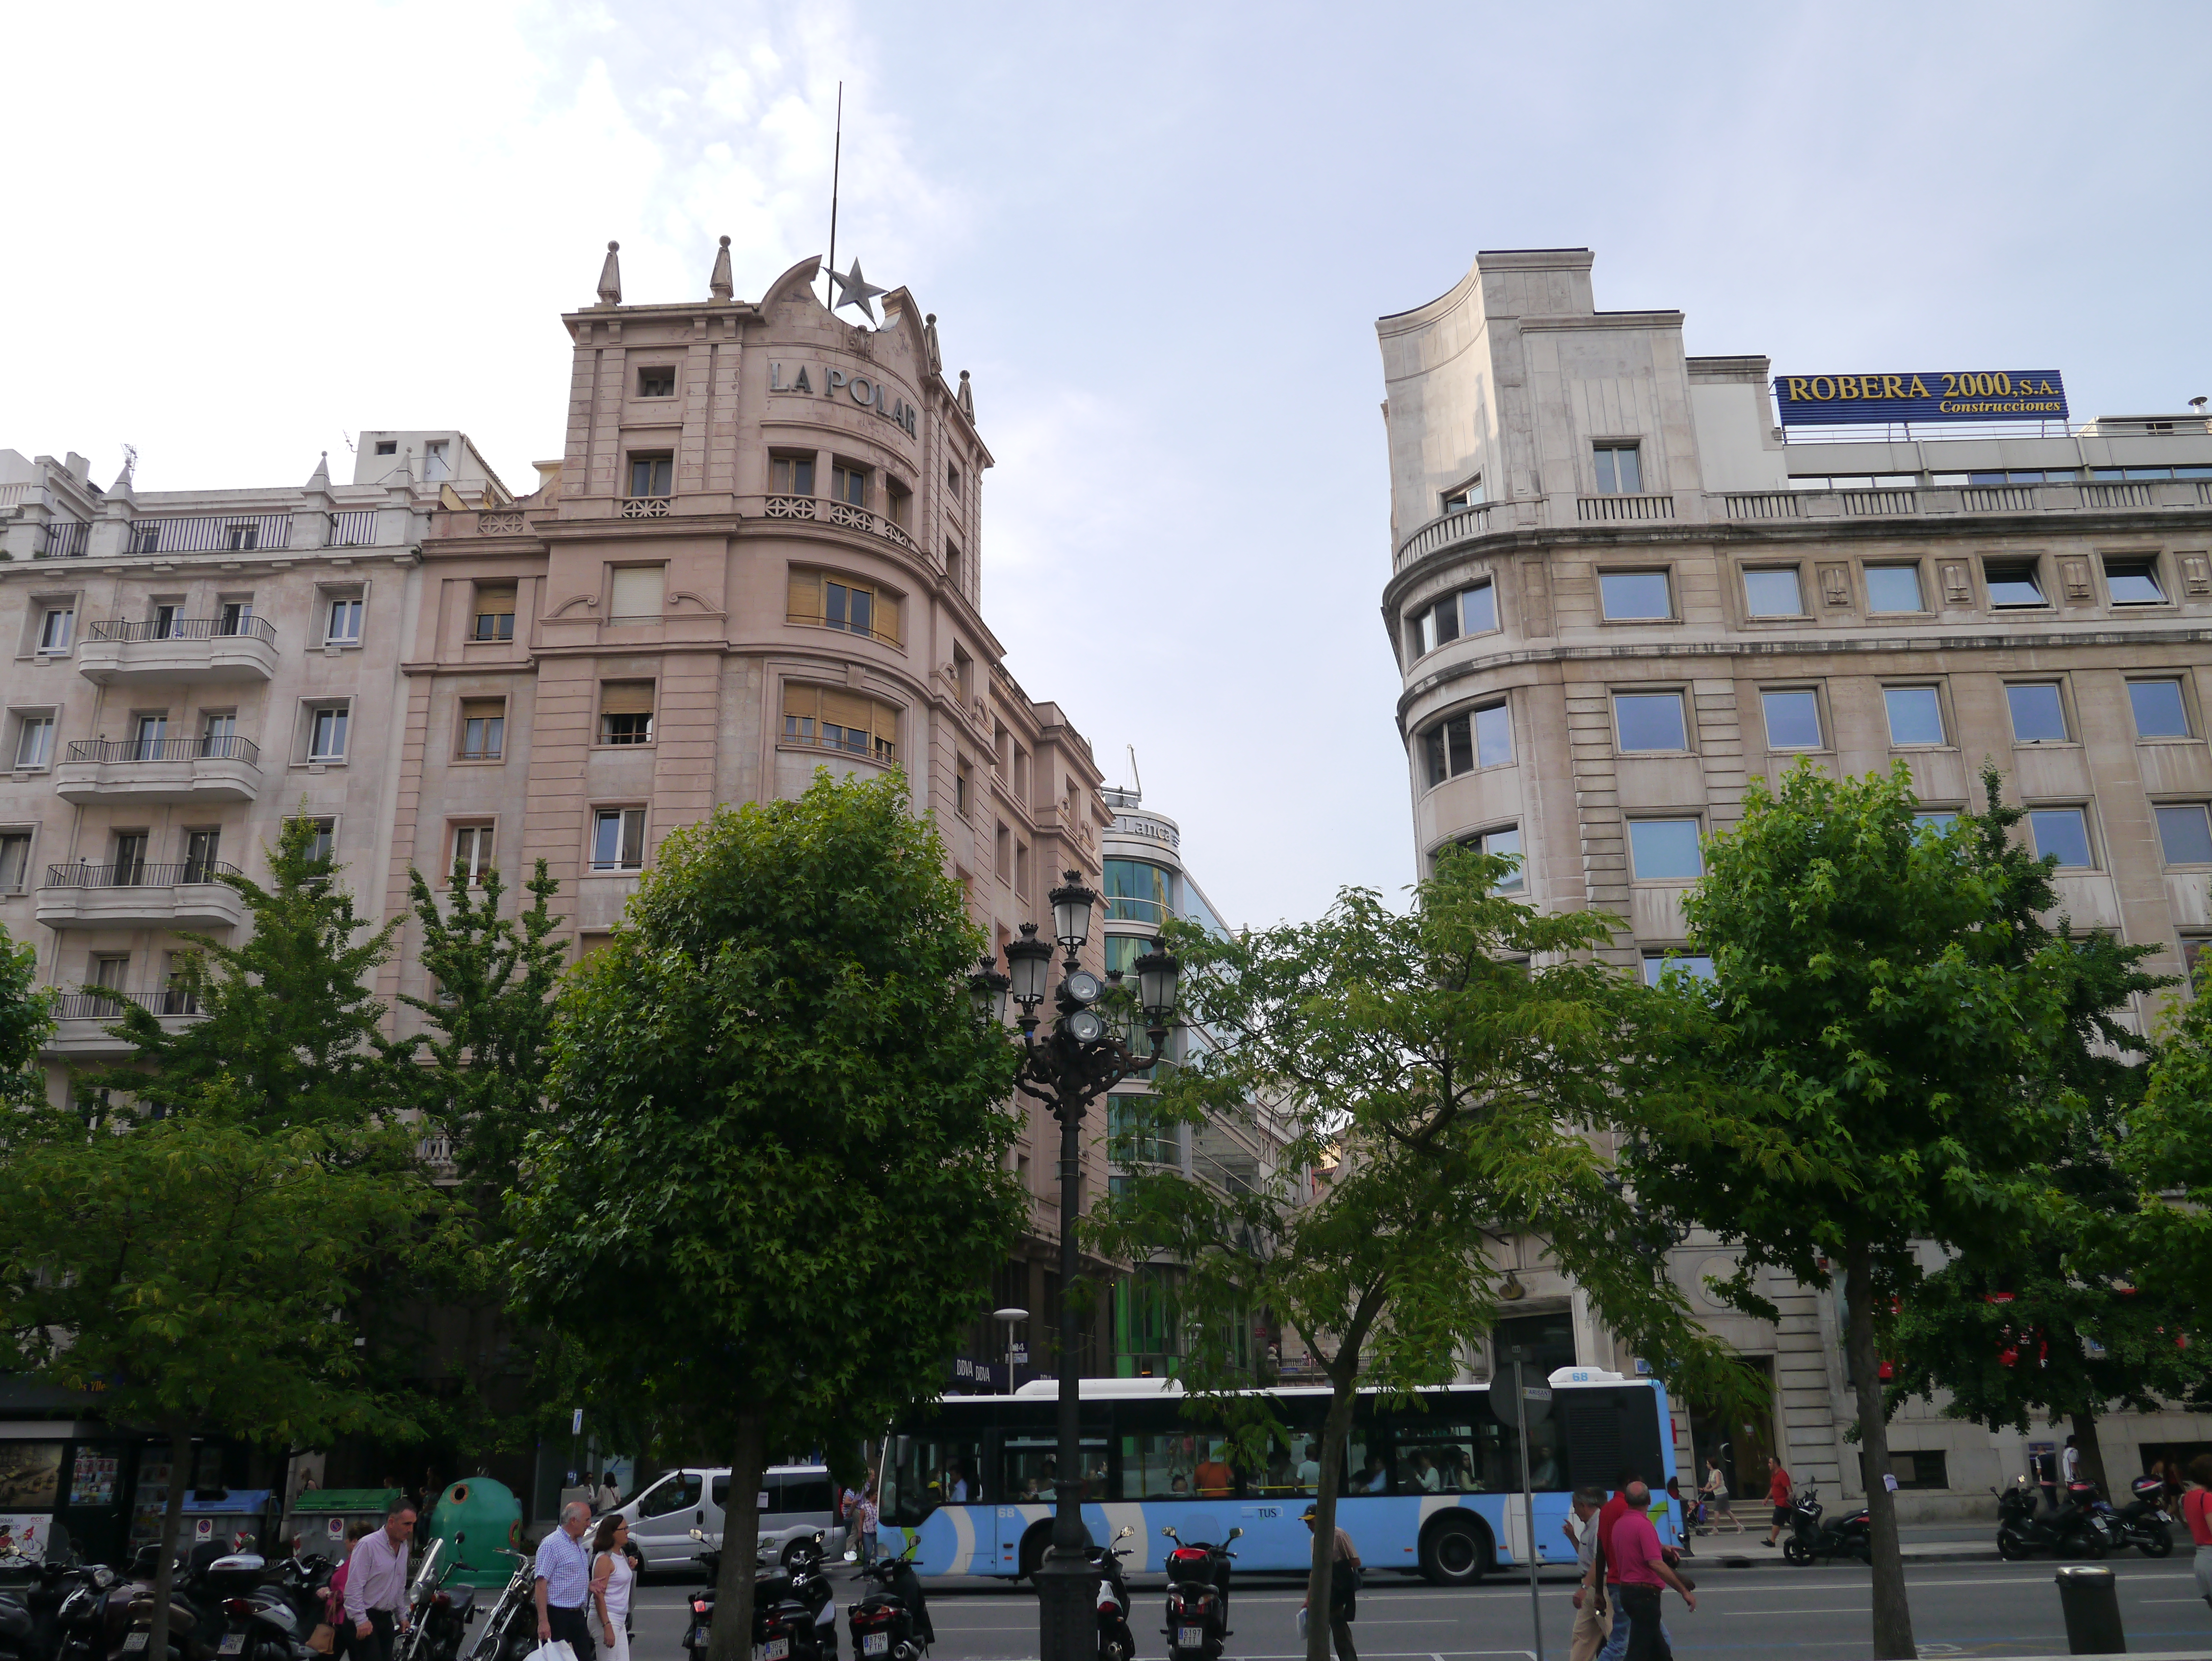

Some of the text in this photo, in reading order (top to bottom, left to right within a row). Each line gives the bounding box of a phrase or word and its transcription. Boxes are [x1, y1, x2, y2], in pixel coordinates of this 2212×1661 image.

[1786, 374, 1931, 401] ROBERA
[770, 362, 917, 440] LA POLAR
[1939, 399, 2061, 414] Construcciones
[957, 1358, 973, 1377] BBVA
[975, 1365, 990, 1383] BBVA
[1572, 1372, 1588, 1381] 68
[999, 1508, 1015, 1517] 68
[1258, 1509, 1277, 1518] TUS
[1184, 1629, 1201, 1637] 6197
[869, 1634, 886, 1643] 8796
[770, 1639, 787, 1649] 3623
[869, 1643, 882, 1651] FTH
